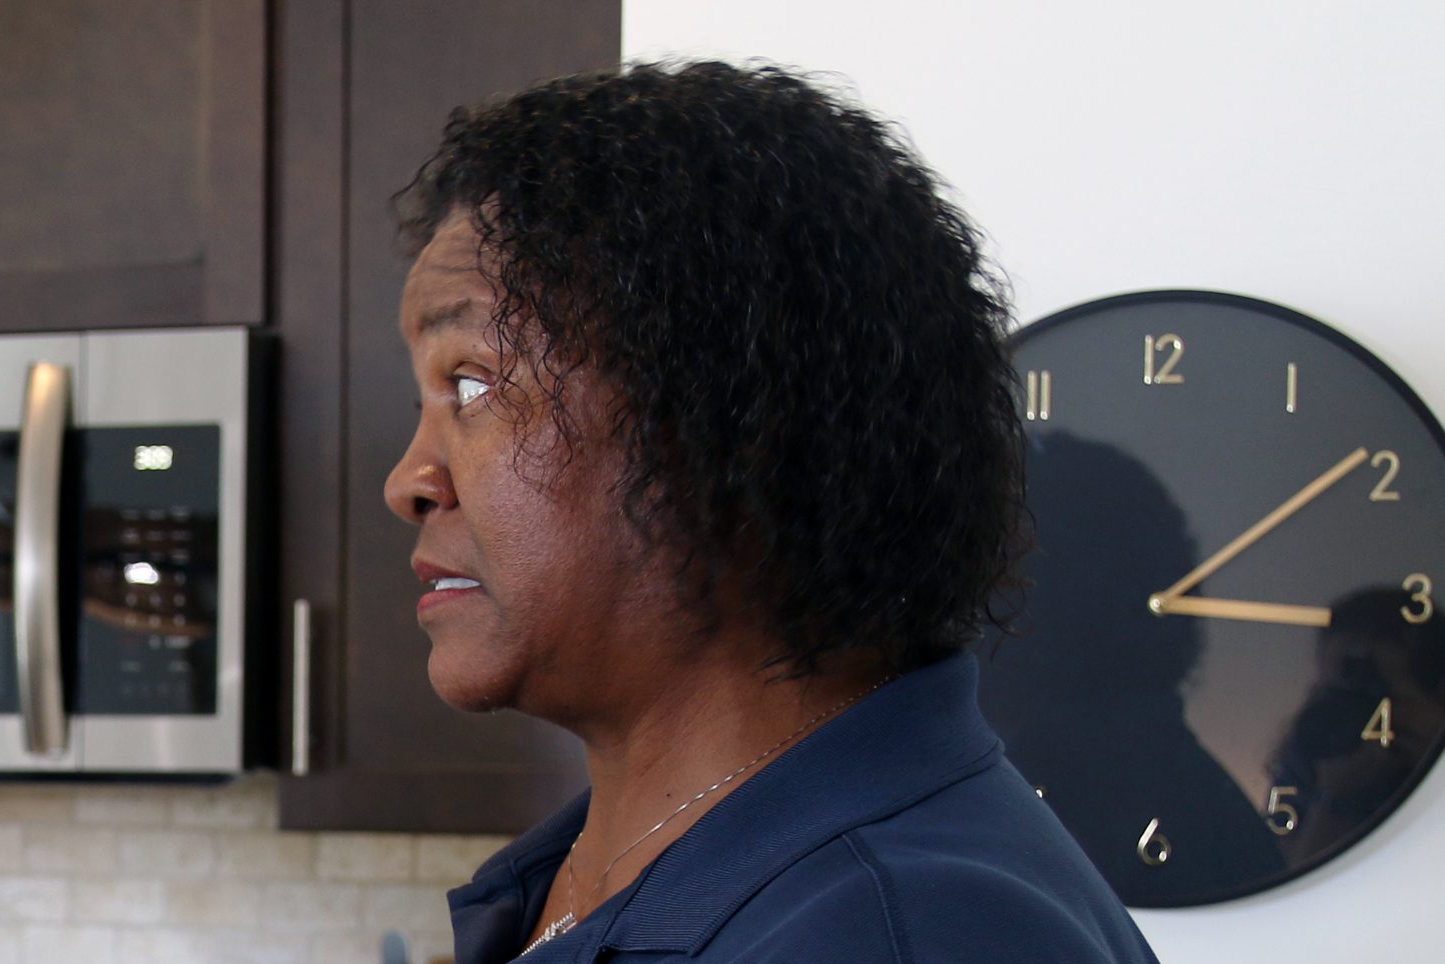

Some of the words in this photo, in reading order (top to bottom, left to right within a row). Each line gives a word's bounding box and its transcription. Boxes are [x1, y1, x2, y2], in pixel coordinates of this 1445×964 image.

[1145, 333, 1185, 384] 12
[1027, 369, 1052, 420] 11
[1285, 362, 1298, 413] 1
[1368, 449, 1401, 501] 2
[1400, 573, 1434, 624] 3
[1361, 697, 1394, 747] 4
[1266, 786, 1299, 835] 5
[1137, 817, 1171, 866] 6
